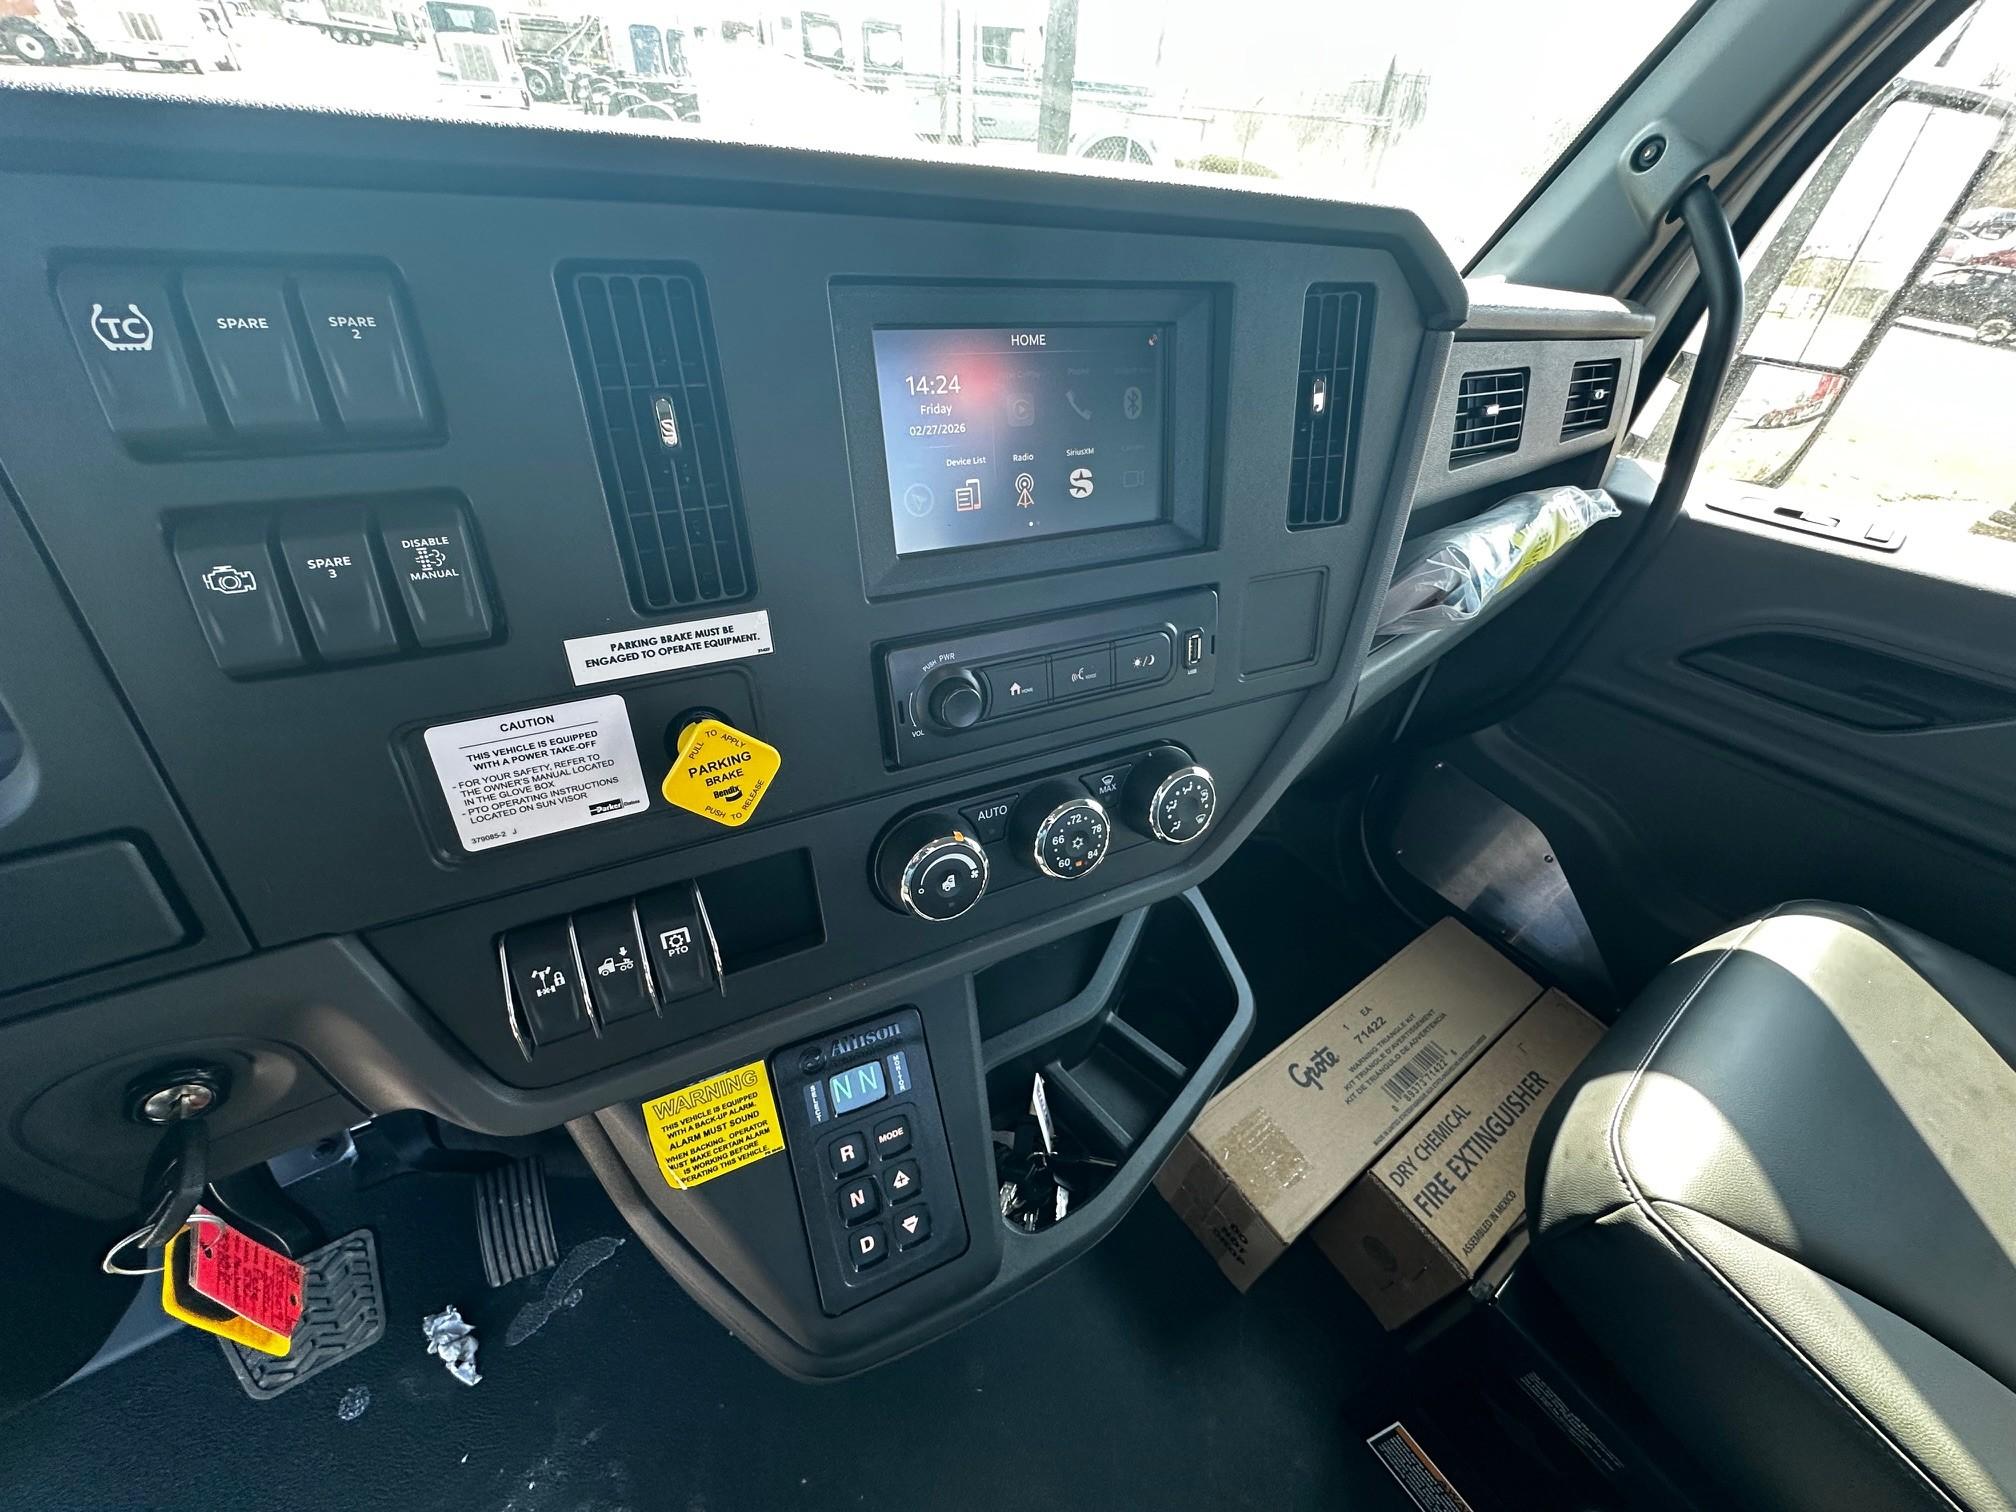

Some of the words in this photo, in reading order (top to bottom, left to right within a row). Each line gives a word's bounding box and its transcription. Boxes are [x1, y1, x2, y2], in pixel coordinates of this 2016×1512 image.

[100, 317, 147, 340] TC
[216, 317, 269, 330] SPARE
[328, 315, 376, 328] SPARE
[352, 328, 362, 340] 2
[1010, 333, 1047, 347] HOME
[904, 374, 961, 397] 14:24
[920, 404, 953, 417] Friday
[908, 423, 967, 438] 02/27/2026
[946, 457, 971, 467] Device
[971, 455, 987, 465] List
[1012, 452, 1035, 463] Radio
[1066, 447, 1095, 457] SiriusXM
[401, 536, 450, 549] DISABLE
[306, 555, 352, 570] SPARE
[328, 568, 338, 580] 3
[409, 567, 460, 582] MANUAL
[610, 637, 659, 652] PARKING
[660, 631, 693, 644] BRAKE
[694, 627, 721, 639] MUST
[722, 625, 734, 634] BE
[585, 652, 640, 668] ENGAGED
[641, 649, 656, 660] TO
[658, 642, 703, 656] OPERATE
[703, 633, 761, 649] EQUIPMENT.
[922, 660, 937, 672] PUSH
[938, 652, 956, 662] PWR
[500, 714, 555, 732] CAUTION
[911, 729, 925, 738] VOL
[465, 751, 491, 762] THIS
[492, 742, 536, 756] VEHICLE
[537, 740, 547, 749] IS
[549, 730, 598, 746] EQUIPPED
[473, 760, 500, 771] WITH
[502, 758, 510, 766] A
[511, 750, 549, 764] POWER
[550, 740, 597, 755] TAKE-OFF
[688, 742, 705, 760] PULL
[705, 729, 718, 738] TO
[720, 733, 747, 749] APPLY
[458, 778, 480, 789] FOR
[481, 772, 512, 784] YOUR
[513, 763, 553, 778] SAFETY,
[554, 756, 586, 769] REFER
[587, 753, 600, 762] TO
[688, 751, 752, 779] PARKING
[461, 788, 482, 798] THE
[483, 777, 530, 793] OWNER'S
[531, 768, 572, 783] MANUAL
[572, 759, 615, 774] LOCATED
[705, 768, 744, 787] BRAKE
[1099, 782, 1118, 795] MAX
[464, 798, 475, 806] IN
[476, 793, 497, 803] THE
[499, 785, 533, 799] GLOVE
[533, 780, 555, 791] BOX
[468, 805, 489, 816] PTO
[491, 792, 549, 810] OPERATING
[550, 776, 619, 797] INSTRUCTIONS
[704, 805, 727, 818] PUSH
[730, 812, 743, 820] TO
[741, 778, 766, 811] RELEASE
[713, 785, 740, 799] Bendix
[470, 808, 517, 824] LOCATED
[519, 804, 534, 813] ON
[535, 799, 557, 810] SUN
[558, 792, 588, 804] VISOR
[594, 801, 622, 813] Parker
[977, 804, 1008, 822] AUTO
[1070, 813, 1083, 825] 72
[1091, 823, 1103, 835] 78
[471, 831, 507, 844] 379085-2
[1052, 834, 1065, 846] 66
[1058, 858, 1071, 869] 60
[1087, 848, 1099, 860] 84
[668, 945, 689, 957] PTO
[1360, 1006, 1373, 1017] EA
[1353, 1016, 1387, 1044] 71422
[1348, 1046, 1378, 1073] WARNING
[1376, 1021, 1407, 1048] TRIANGLE
[1404, 1012, 1416, 1024] KIT
[892, 1054, 906, 1091] MONITOR
[1288, 1046, 1340, 1091] Grote
[1343, 1079, 1356, 1092] KIT
[1355, 1052, 1387, 1079] TRIANGLE
[1344, 1092, 1357, 1105] KIT
[1355, 1084, 1368, 1095] DE
[1399, 1045, 1411, 1056] DE
[832, 1075, 852, 1103] N
[858, 1066, 878, 1093] N
[1403, 1079, 1427, 1102] 89373
[1424, 1060, 1449, 1081] 71422
[652, 1069, 758, 1121] WARNING
[809, 1084, 822, 1122] SELECT
[661, 1121, 679, 1133] THIS
[680, 1109, 712, 1126] VEHICLE
[713, 1105, 721, 1114] IS
[721, 1091, 758, 1110] EQUIPPED
[667, 1127, 687, 1139] WITH
[694, 1111, 728, 1129] BACK-UP
[729, 1101, 756, 1115] ALARM.
[665, 1149, 689, 1164] WHEN
[728, 1119, 768, 1139] OPERATOR
[669, 1130, 702, 1151] ALARM
[703, 1123, 727, 1138] MUST
[729, 1110, 760, 1127] SOUND
[878, 1126, 904, 1145] MODE
[668, 1160, 688, 1171] MUST
[689, 1152, 712, 1166] MAKE
[712, 1138, 744, 1154] CERTAIN
[745, 1127, 771, 1143] ALARM
[840, 1143, 854, 1162] R
[1389, 1155, 1418, 1188] DRY
[1414, 1104, 1471, 1161] CHEMICAL
[1412, 1171, 1457, 1219] FIRE
[1445, 1070, 1550, 1182] EXTINGUISHER
[683, 1167, 691, 1175] IS
[692, 1152, 728, 1172] WORKING
[729, 1140, 759, 1157] BEFORE
[680, 1166, 719, 1184] PERATING
[720, 1158, 737, 1169] THIS
[849, 1188, 865, 1208] N
[1495, 1190, 1517, 1216] MEXICO
[1491, 1211, 1500, 1223] IN
[859, 1234, 875, 1253] D
[1462, 1219, 1494, 1256] ASSEMBLED
